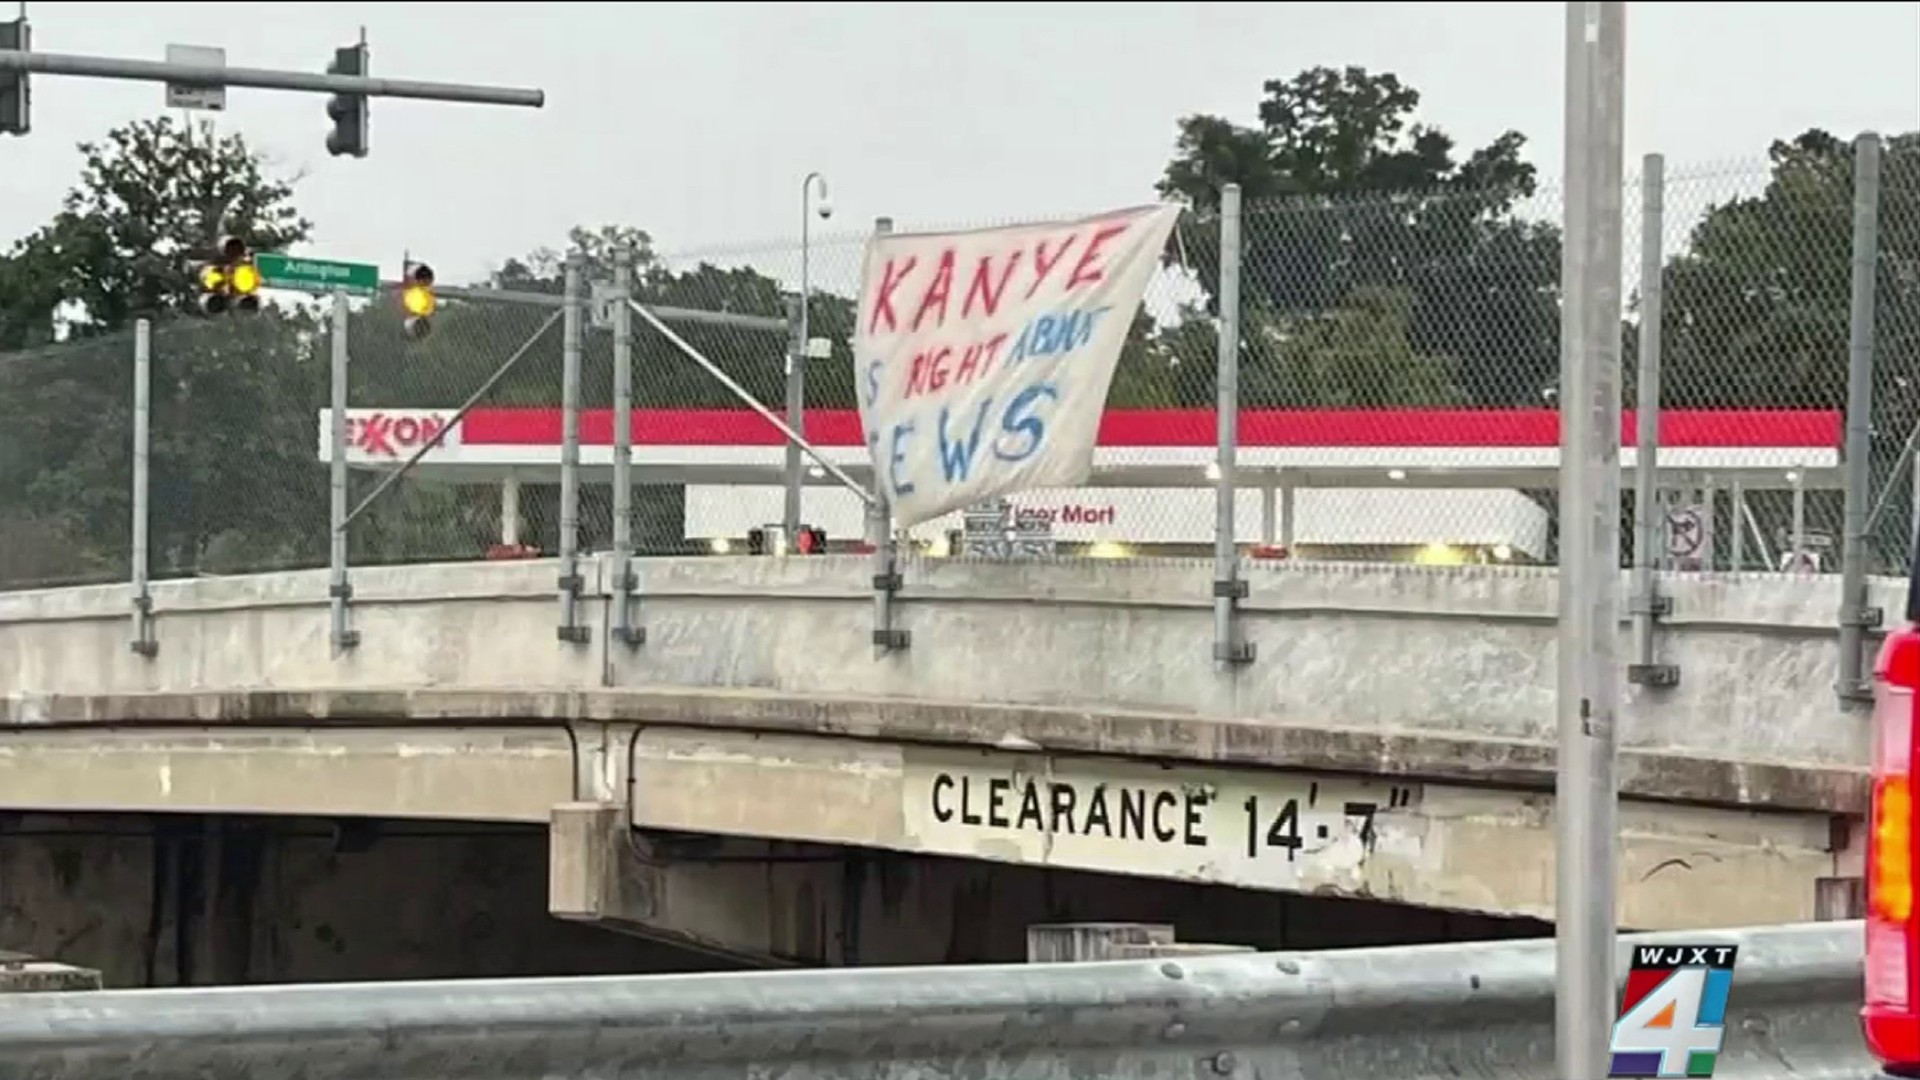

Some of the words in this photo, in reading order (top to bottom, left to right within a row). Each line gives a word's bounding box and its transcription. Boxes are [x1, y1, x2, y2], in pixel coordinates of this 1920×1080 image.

[869, 223, 1130, 336] KANYE
[868, 381, 1058, 496] EWS
[1062, 504, 1115, 524] Mart
[932, 773, 1210, 847] CLEARANCE
